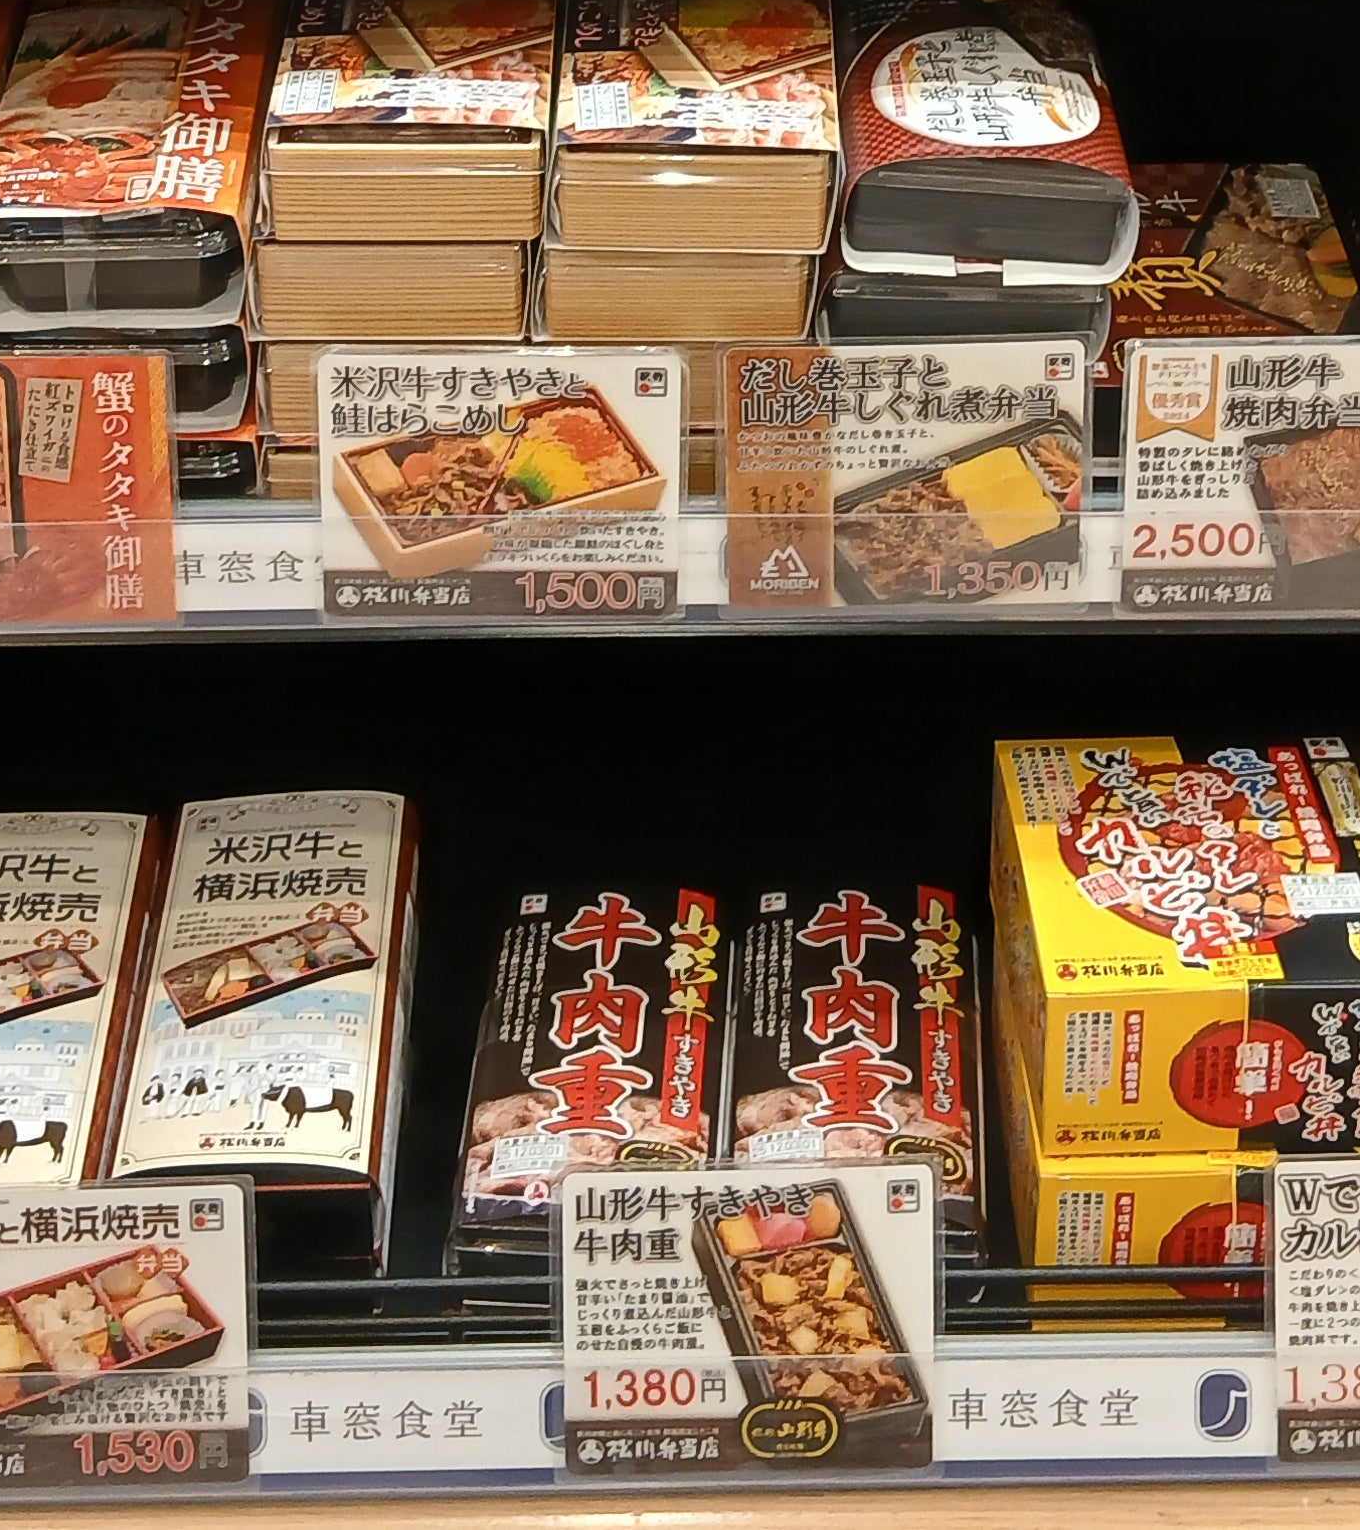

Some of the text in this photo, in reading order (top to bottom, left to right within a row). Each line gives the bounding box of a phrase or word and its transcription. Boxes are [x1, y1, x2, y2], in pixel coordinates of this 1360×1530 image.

[330, 365, 588, 400] 米沢牛すきやきと
[739, 356, 949, 393] だし巻玉子と
[1226, 356, 1343, 391] 山形牛
[330, 402, 526, 436] 鮭はらこめし
[740, 386, 1059, 427] 山形牛しぐれ煮弁当
[1152, 392, 1202, 409] 優秀賞
[90, 370, 144, 611] 蟹のタタキ御膳
[1136, 488, 1230, 500] 詰め込みました
[1132, 523, 1287, 560] 2,500円
[515, 571, 667, 614] 1,500円
[925, 561, 1071, 597] 1,350円
[206, 835, 364, 866] 米沢牛と
[193, 867, 369, 904] 横浜焼売
[312, 904, 367, 923] 弁当
[40, 931, 97, 952] 弁当
[529, 893, 661, 1139] 牛肉重
[788, 890, 913, 1136] 牛肉重
[574, 1183, 815, 1222] 山形牛すきやき
[136, 1252, 189, 1275] 弁当
[573, 1227, 682, 1263] 牛肉重
[584, 1368, 728, 1410] 1,380円
[290, 1401, 484, 1442] 車窓食堂
[948, 1388, 1140, 1428] 車窓食堂
[73, 1431, 229, 1477] 1,530円
